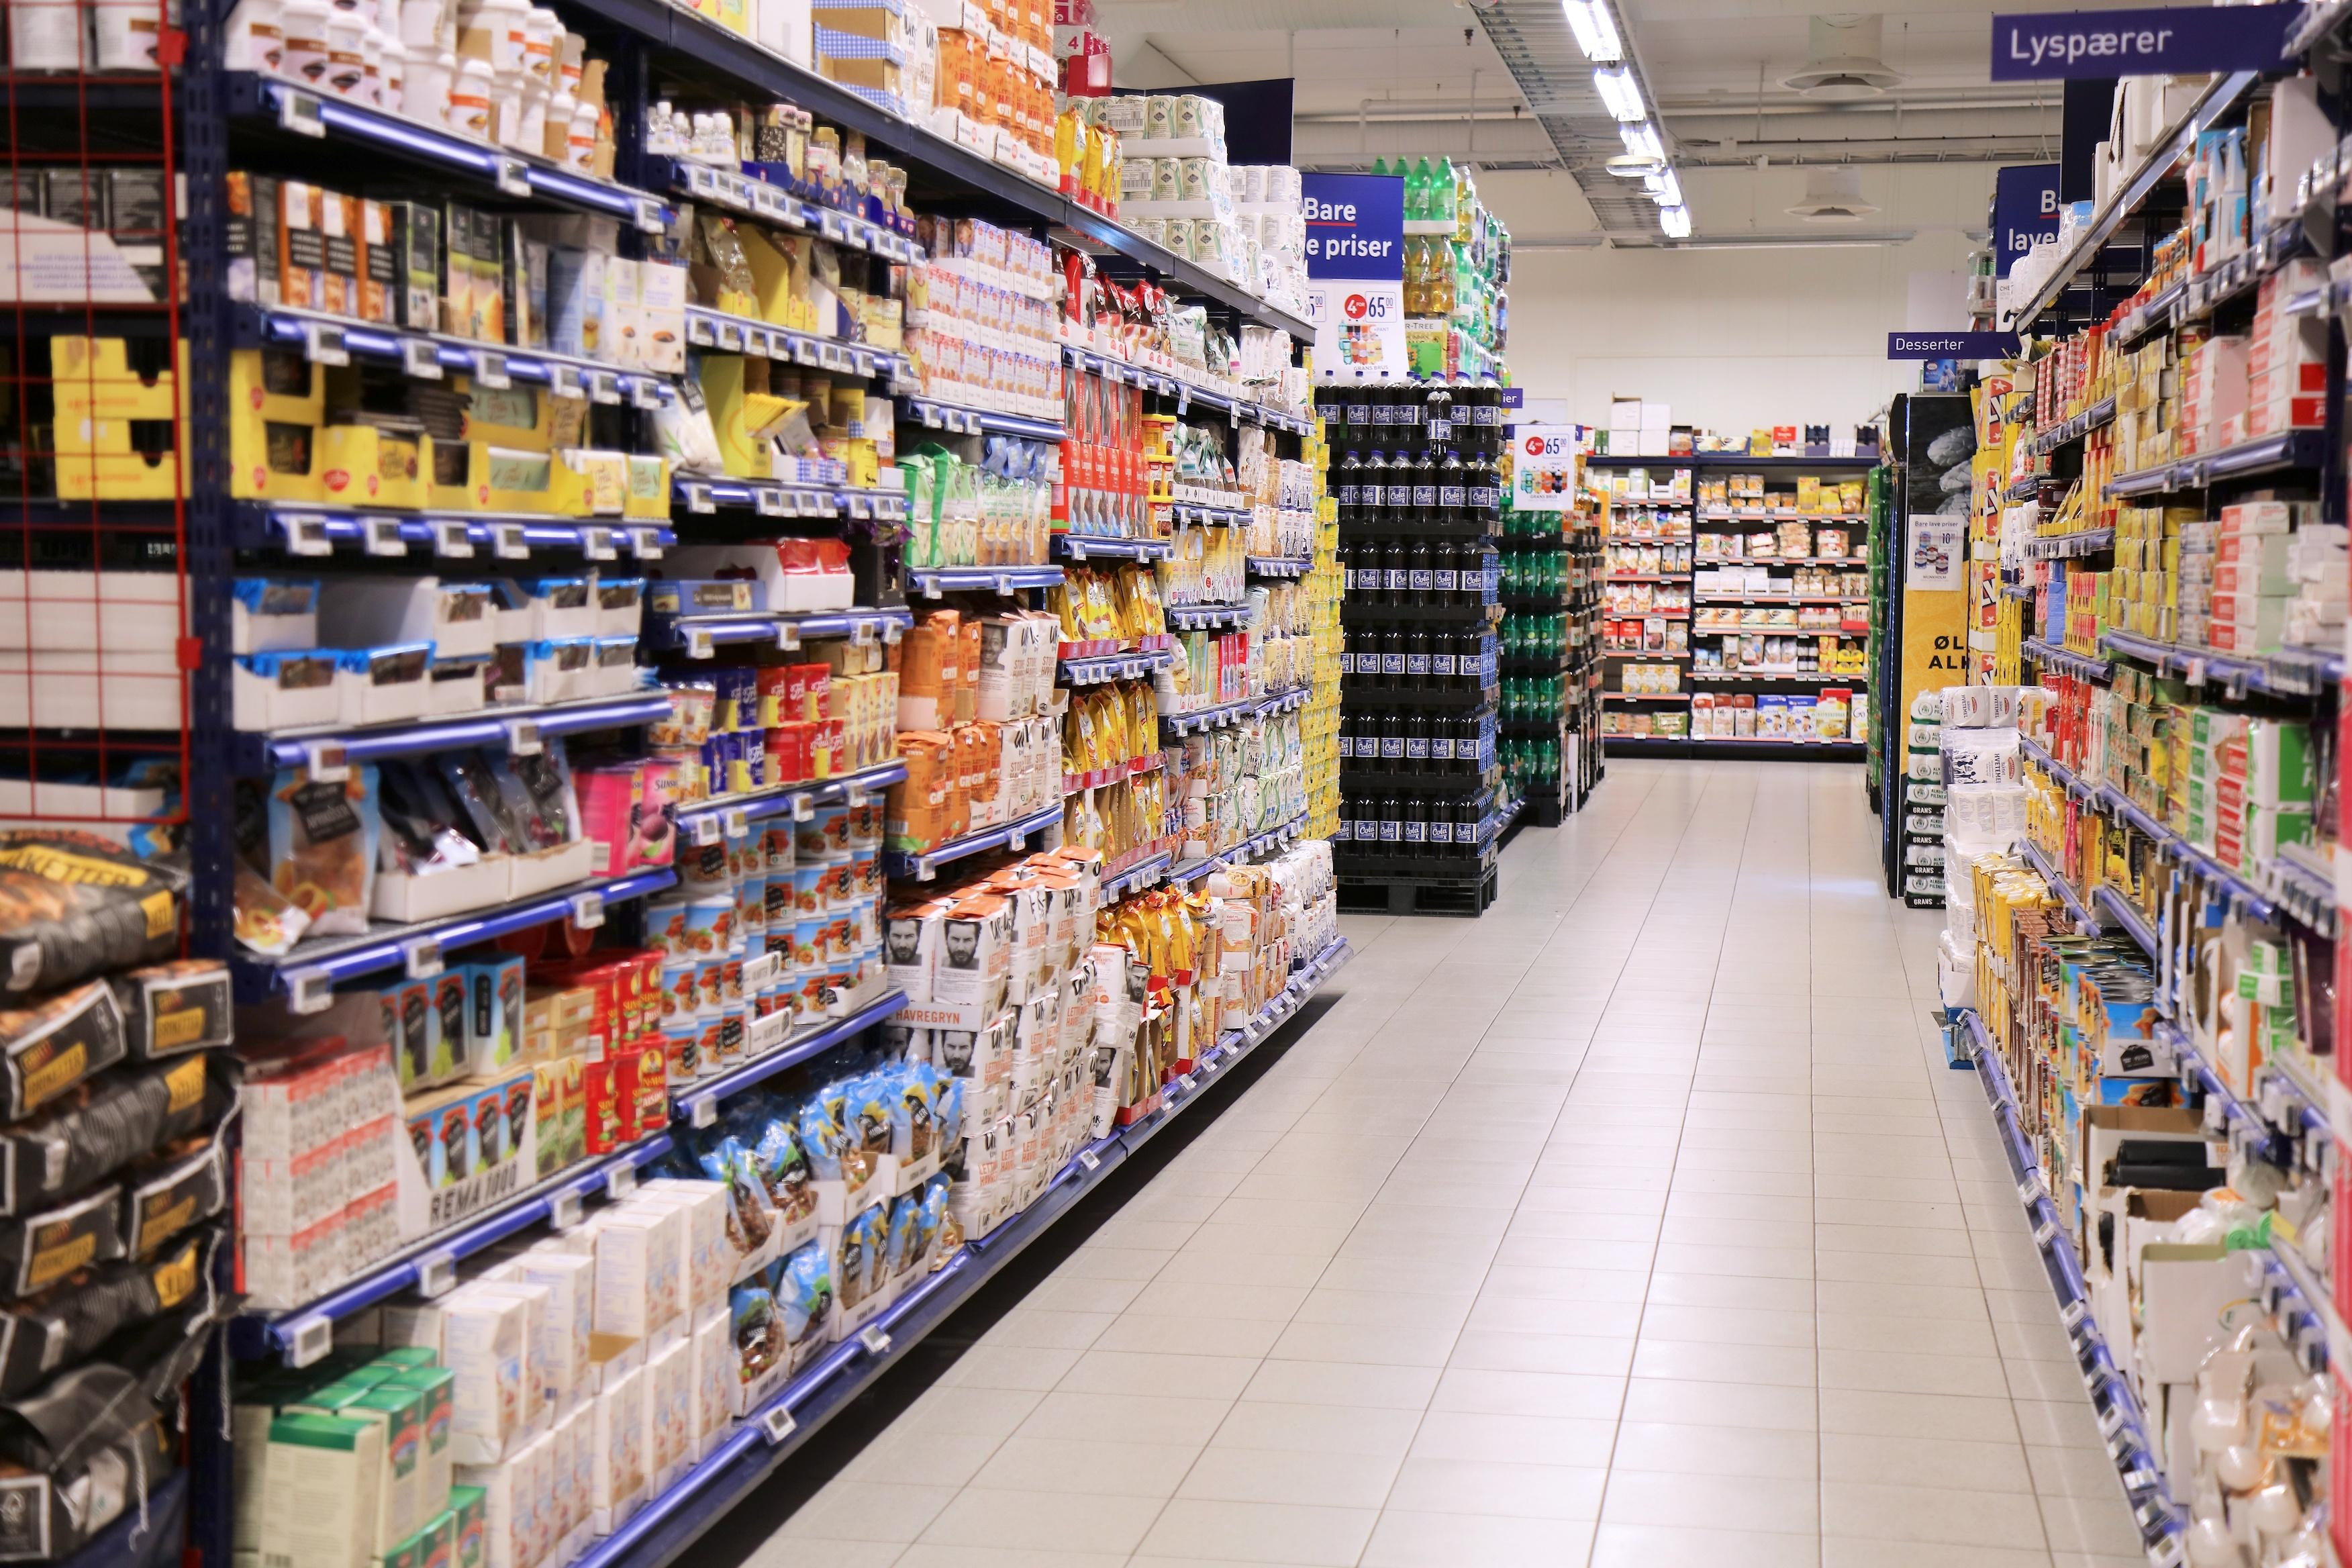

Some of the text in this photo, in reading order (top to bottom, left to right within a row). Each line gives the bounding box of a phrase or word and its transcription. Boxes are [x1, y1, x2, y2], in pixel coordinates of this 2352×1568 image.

[1067, 36, 1079, 50] 4
[2010, 28, 2173, 66] Lyspærer
[1304, 197, 1357, 222] Bare
[1326, 234, 1392, 260] priser
[1346, 299, 1357, 314] 4
[1369, 297, 1385, 317] 65
[1896, 338, 1964, 350] Desserter
[1502, 393, 1518, 403] ier
[1527, 440, 1536, 452] 4
[1545, 438, 1559, 454] 65
[1942, 533, 1950, 544] 10
[1934, 635, 1965, 650] ØL
[655, 779, 678, 791] SUNSW
[895, 1010, 961, 1025] HAVREGRYN
